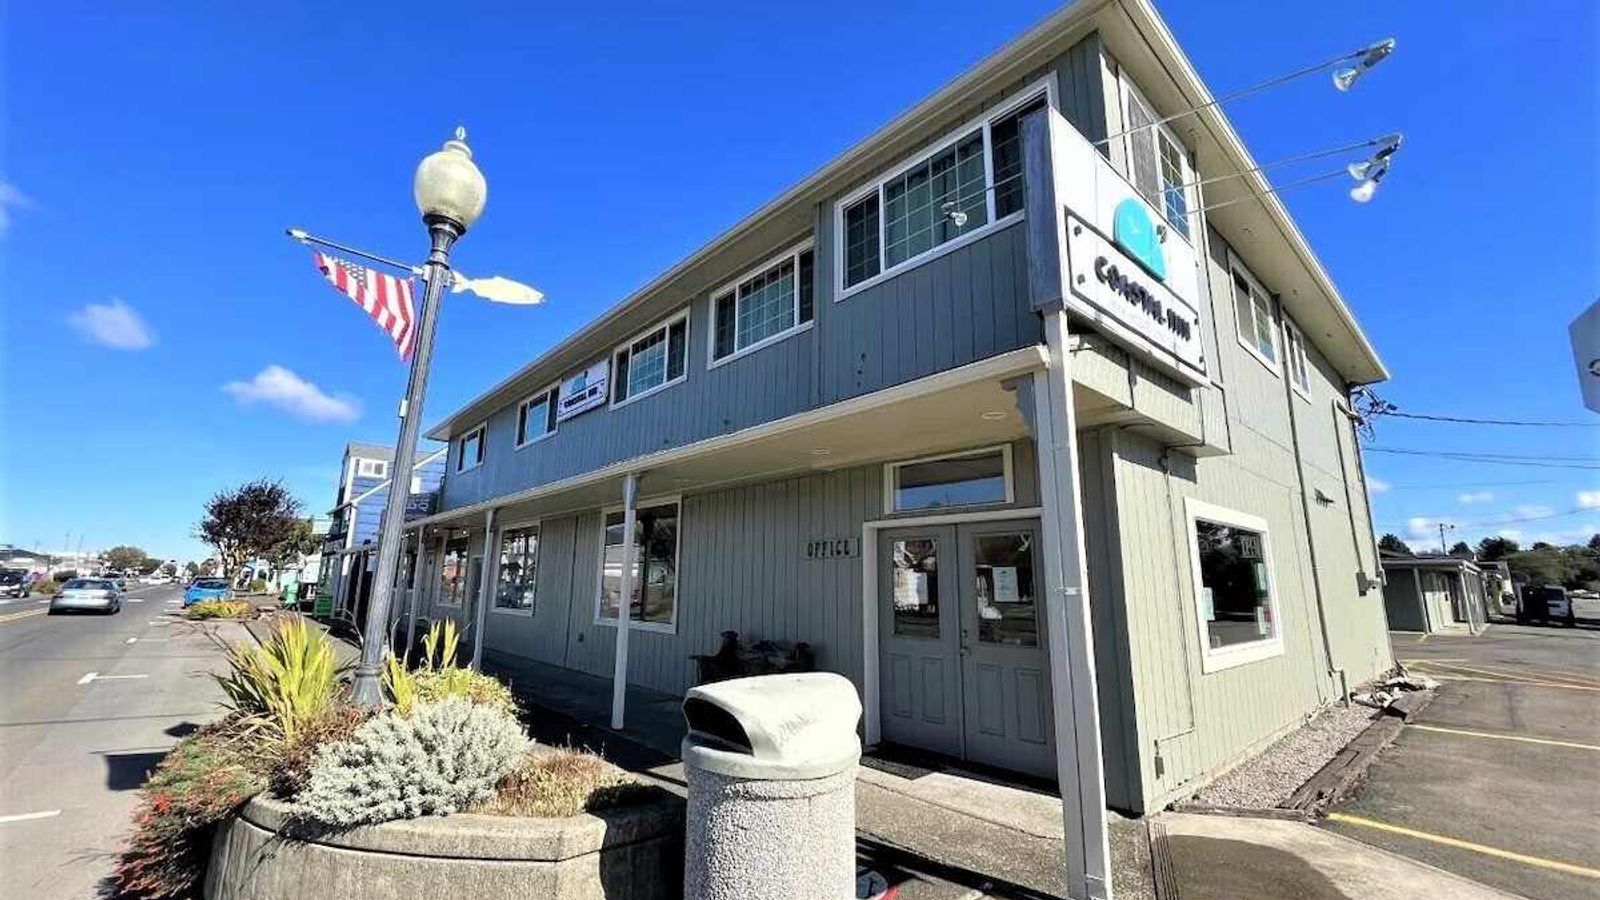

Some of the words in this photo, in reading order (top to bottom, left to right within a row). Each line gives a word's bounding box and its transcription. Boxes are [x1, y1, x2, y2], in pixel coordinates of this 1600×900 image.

[1094, 256, 1166, 325] COASTAL
[1166, 311, 1191, 342] INN
[807, 540, 850, 558] OFFICE
